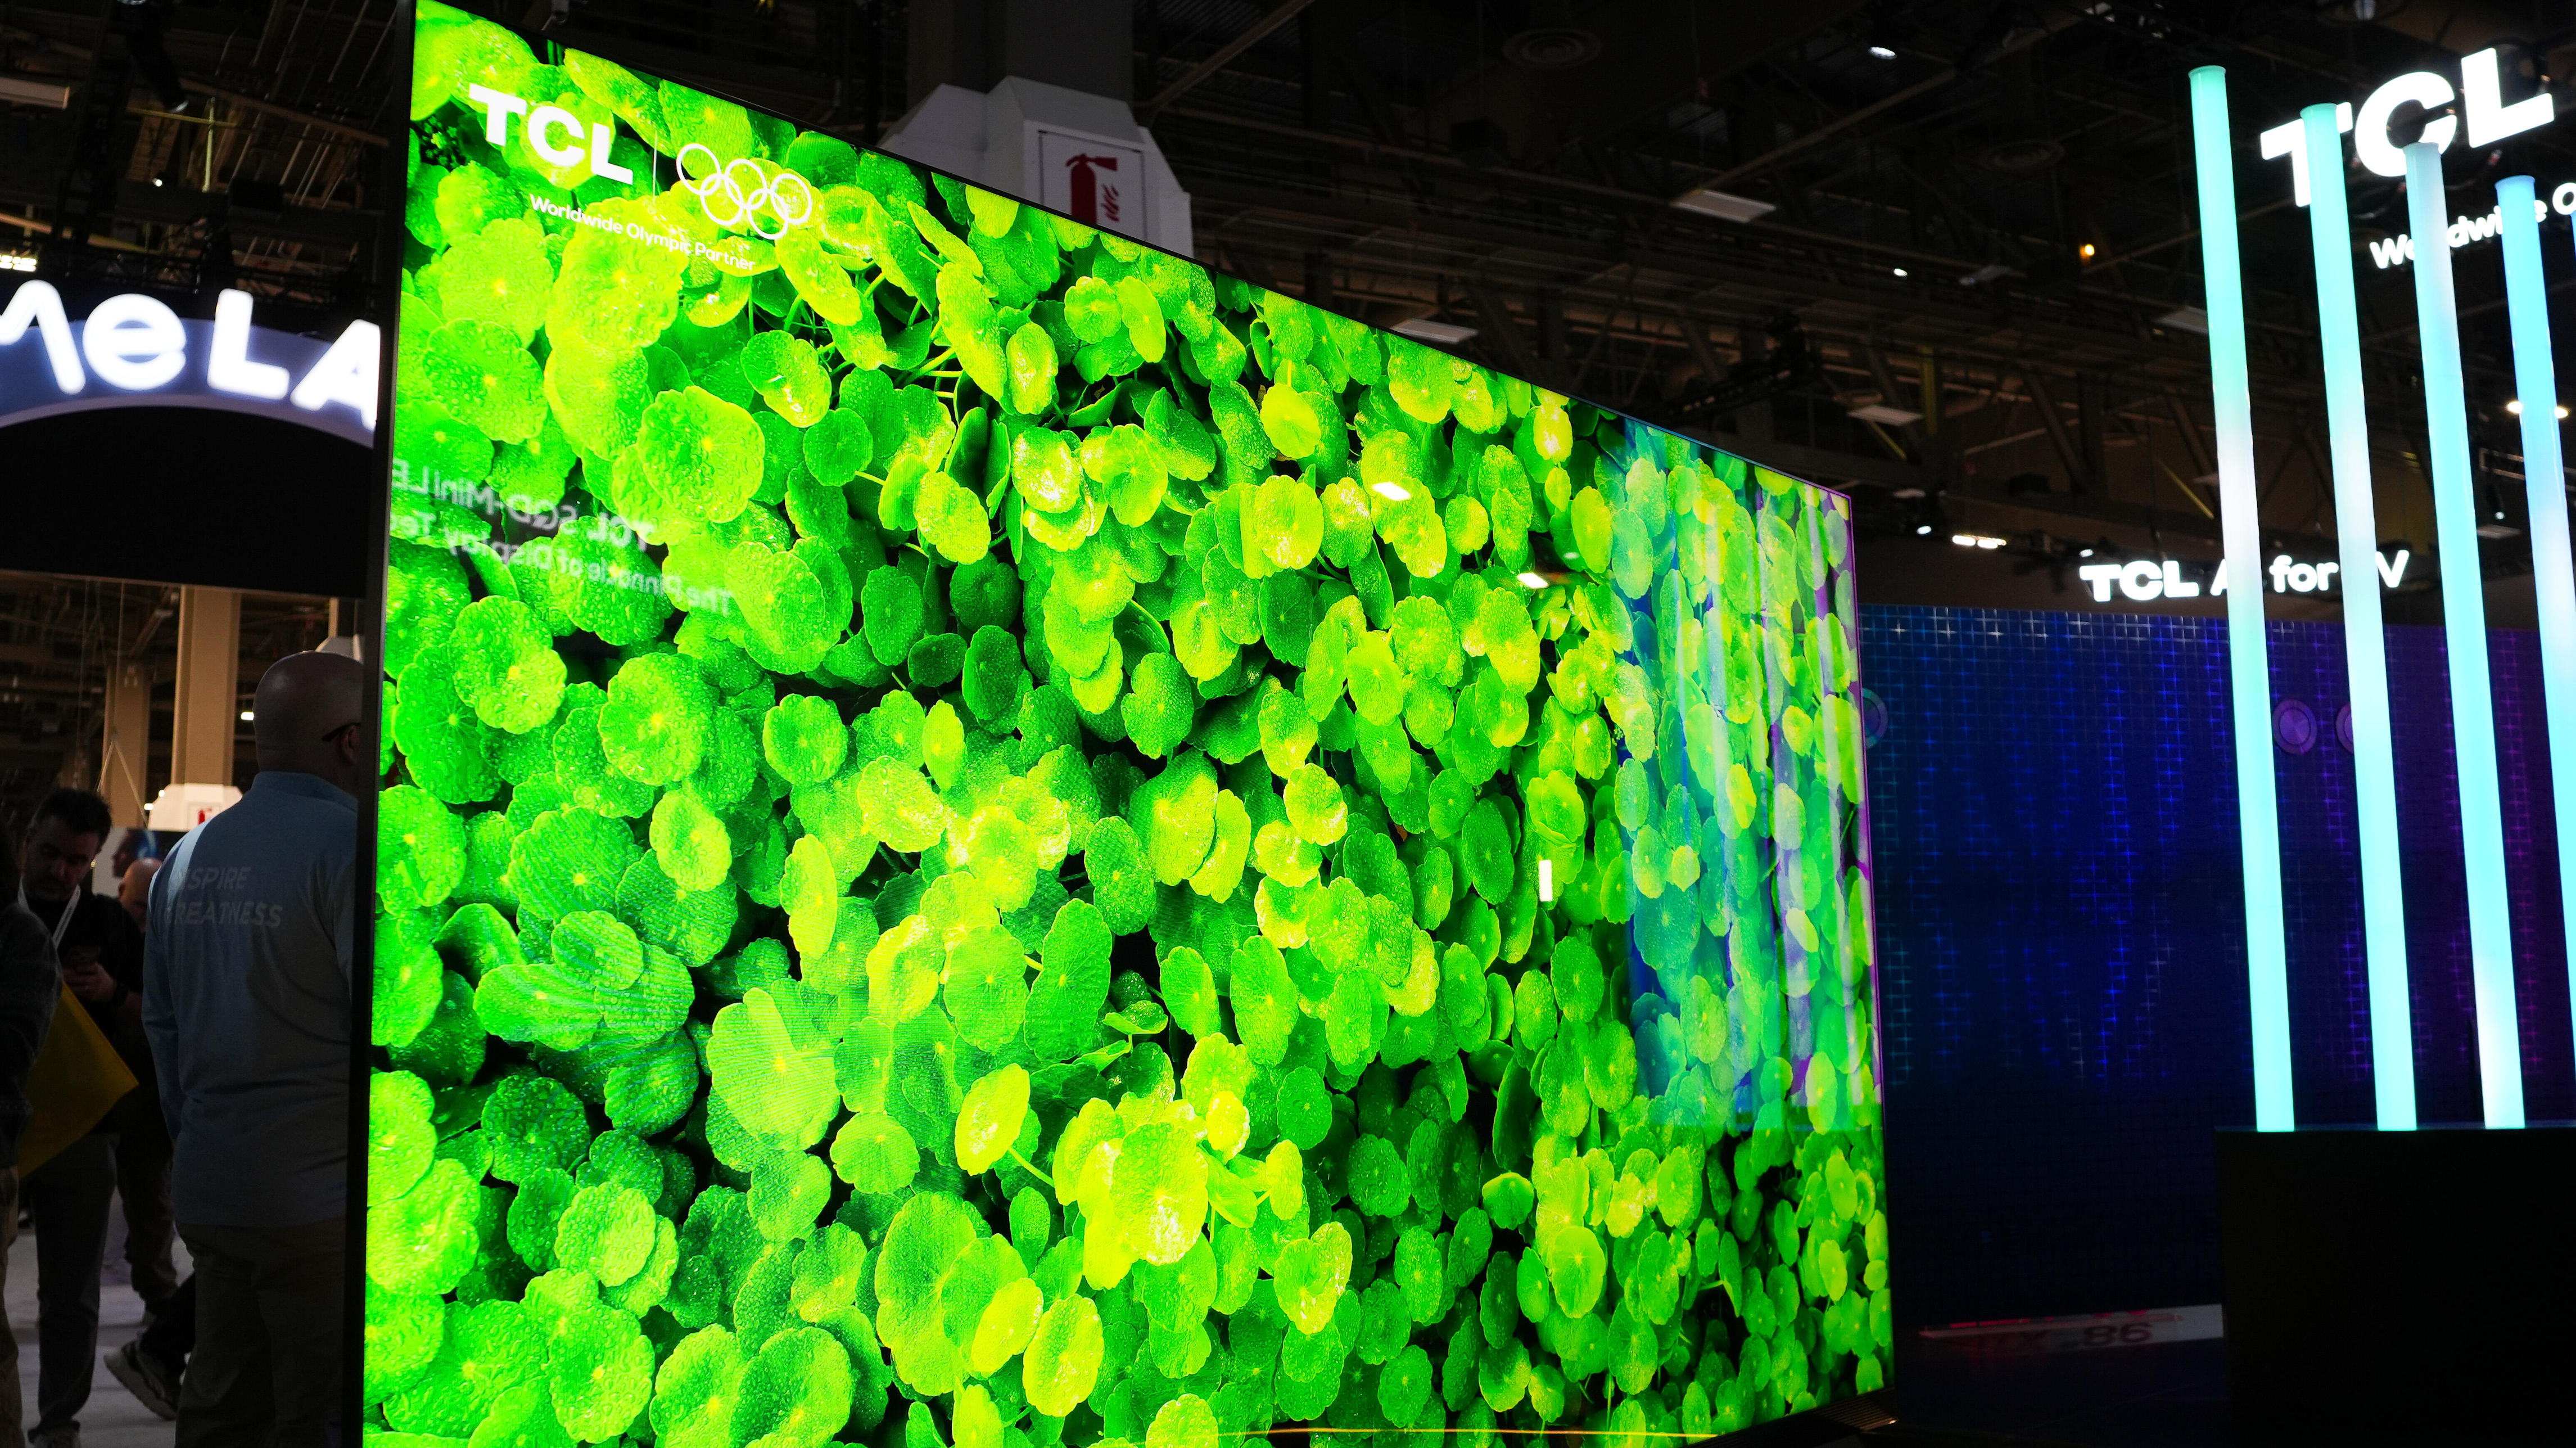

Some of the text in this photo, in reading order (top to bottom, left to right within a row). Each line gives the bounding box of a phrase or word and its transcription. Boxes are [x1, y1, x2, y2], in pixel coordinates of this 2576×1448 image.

[469, 83, 634, 185] TCL
[2260, 47, 2555, 207] TCL
[529, 193, 756, 272] Worldwide Olympic Partner
[2369, 200, 2548, 269] Wodwie
[2079, 560, 2199, 602] TCL
[2268, 554, 2339, 593] for
[2374, 549, 2410, 588] V
[165, 900, 283, 927] REATNESS
